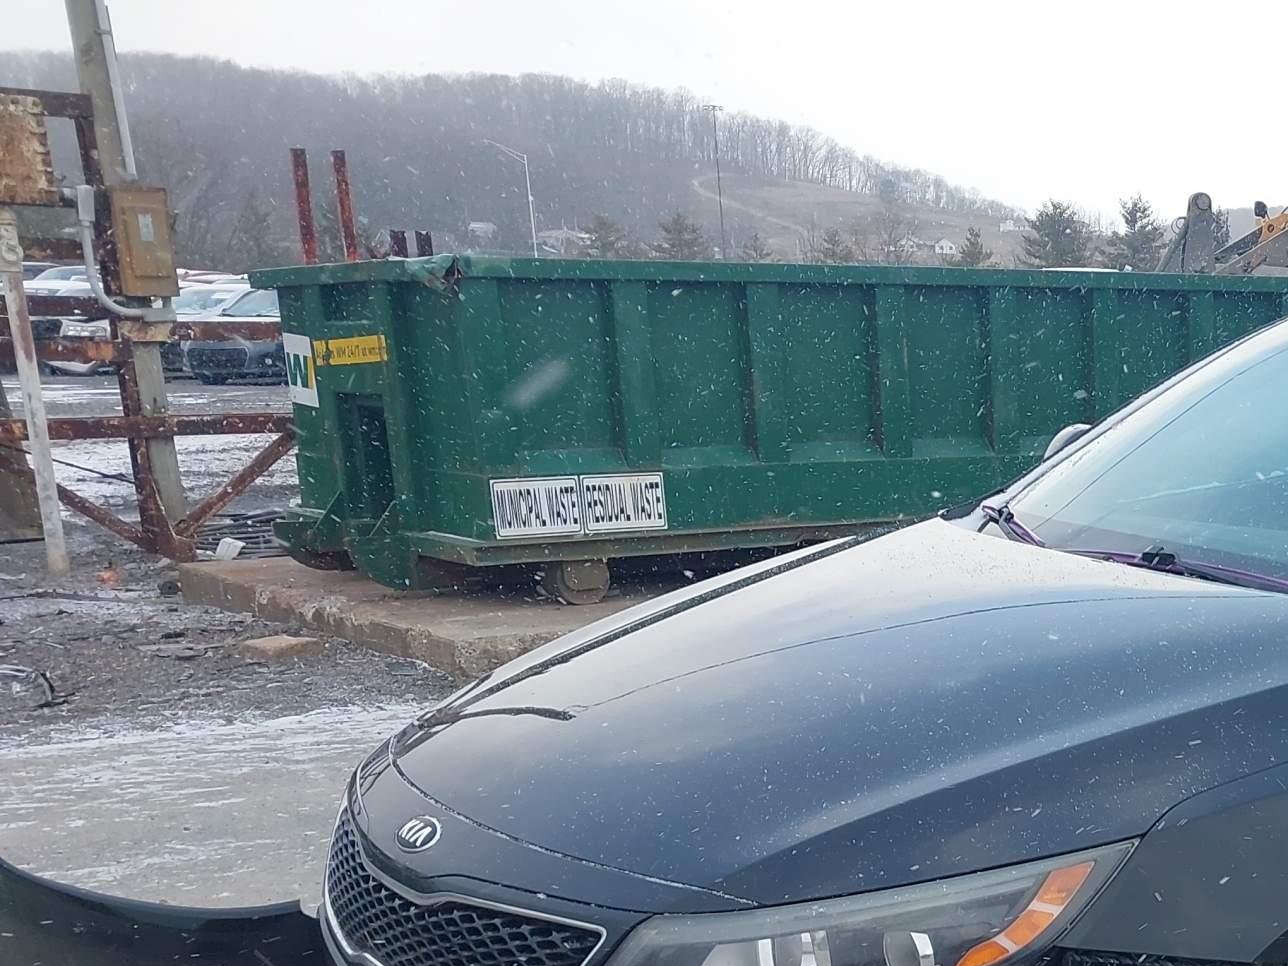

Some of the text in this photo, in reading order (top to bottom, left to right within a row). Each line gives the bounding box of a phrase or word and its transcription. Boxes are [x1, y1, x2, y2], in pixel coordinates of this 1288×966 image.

[496, 485, 578, 529] MUNICIPAL WASTE
[585, 481, 662, 524] RESIDUAL WASTE
[398, 818, 433, 847] KIA
